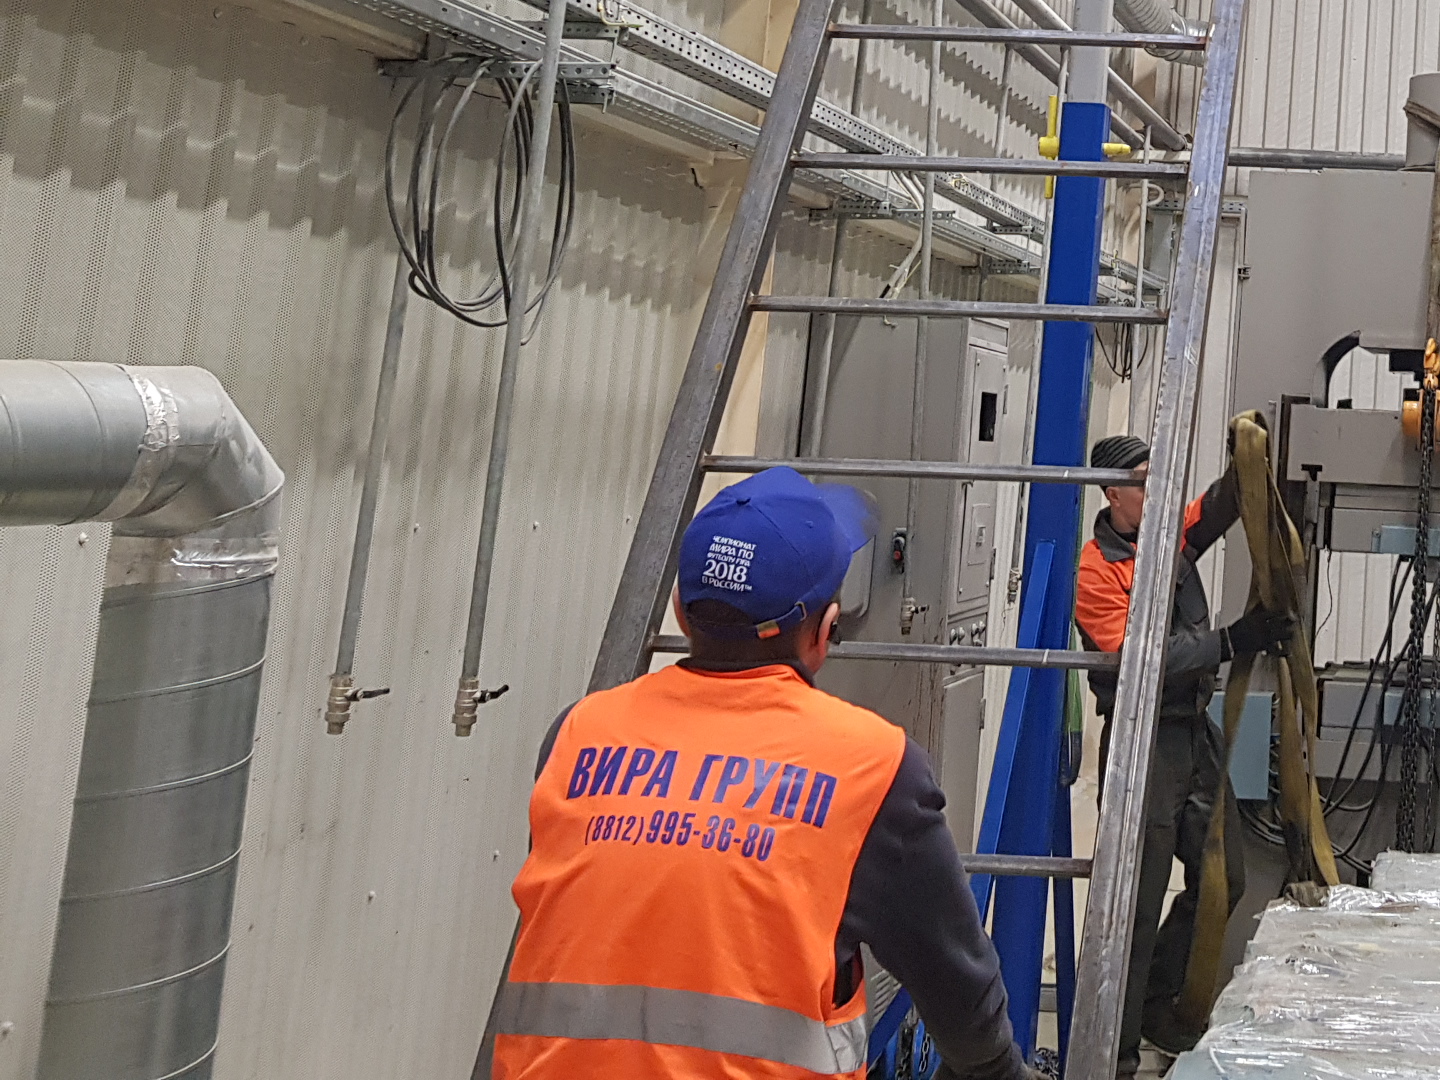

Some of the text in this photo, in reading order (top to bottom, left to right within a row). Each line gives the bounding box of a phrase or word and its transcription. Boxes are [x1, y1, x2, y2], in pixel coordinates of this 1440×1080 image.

[713, 535, 757, 550] ЧЕМПИОНАТ
[709, 543, 754, 560] МИРА ПО
[701, 575, 708, 584] В
[703, 559, 748, 583] 2018
[566, 746, 837, 828] ВИРА ГРУПП
